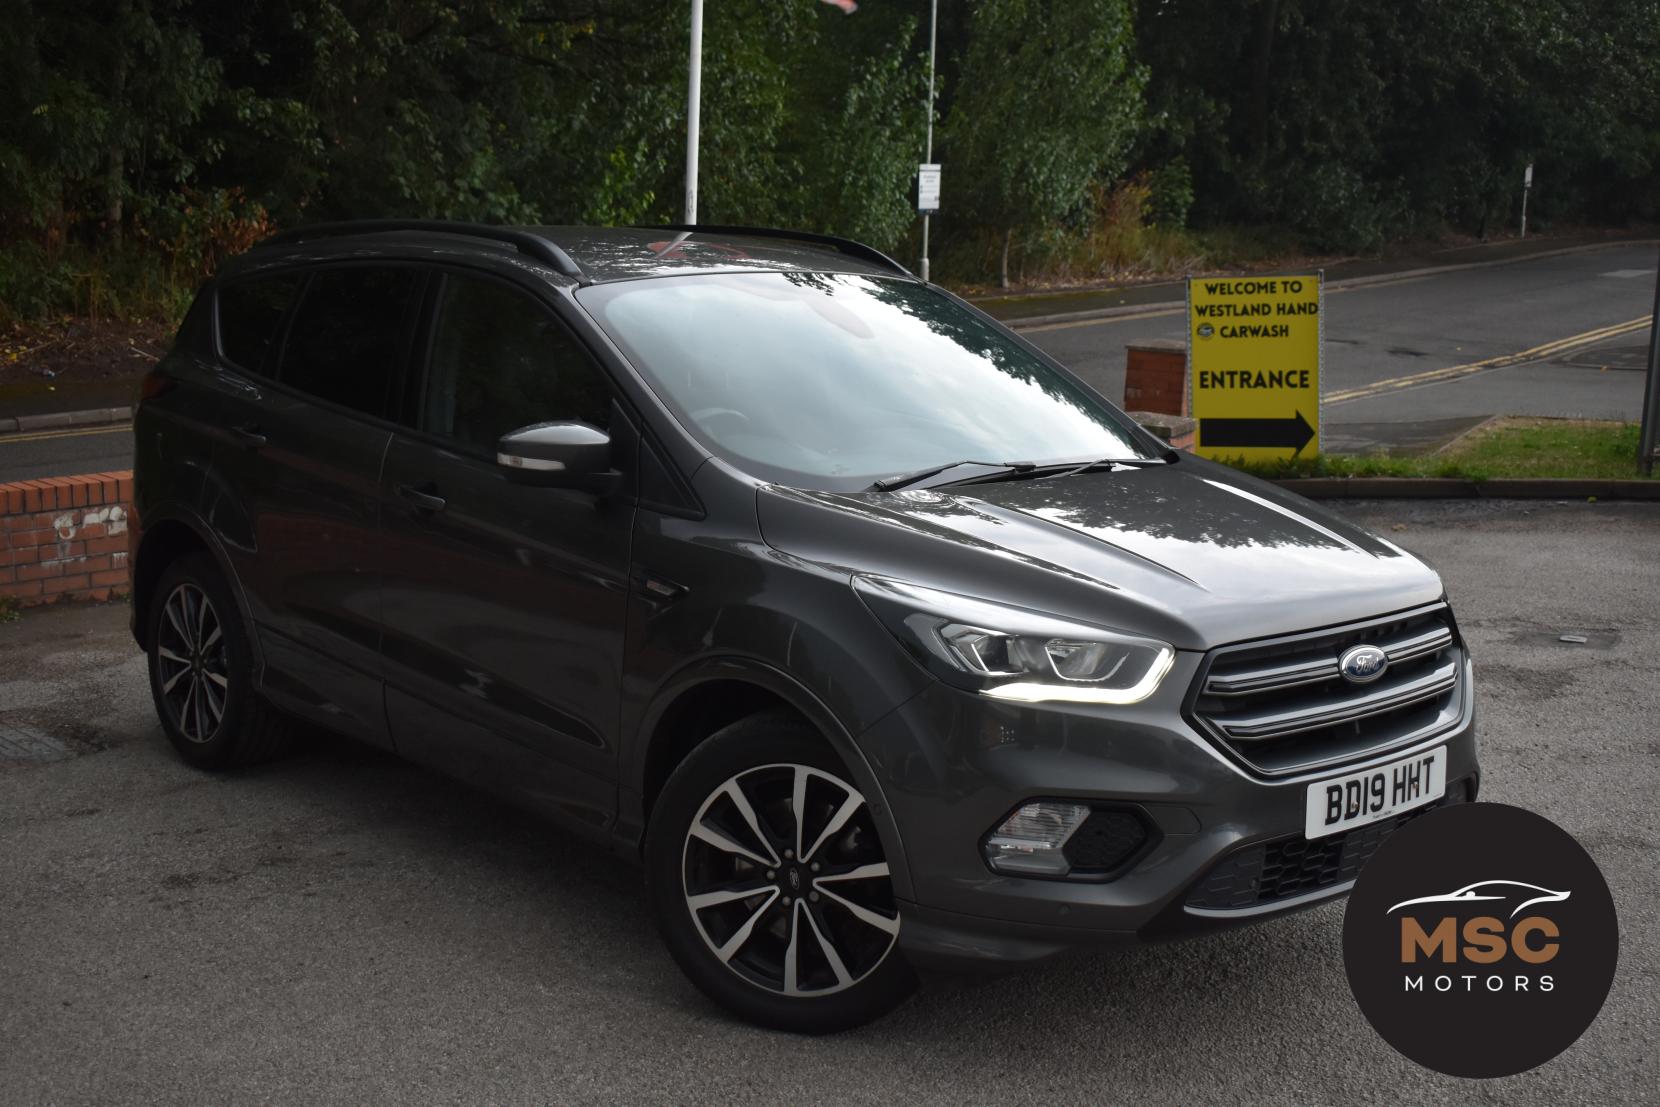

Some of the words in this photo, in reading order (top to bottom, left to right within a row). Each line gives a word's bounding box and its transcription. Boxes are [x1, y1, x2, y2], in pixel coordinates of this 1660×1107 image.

[1205, 281, 1277, 295] WELCOME
[1281, 281, 1303, 293] TO
[1195, 303, 1272, 317] WESTLAND
[1276, 302, 1318, 315] HAND
[1219, 325, 1289, 338] CARWASH
[1199, 370, 1310, 389] ENTRANCE
[1356, 654, 1380, 673] Ford
[1325, 772, 1386, 826] BD19
[1391, 755, 1435, 807] HHT
